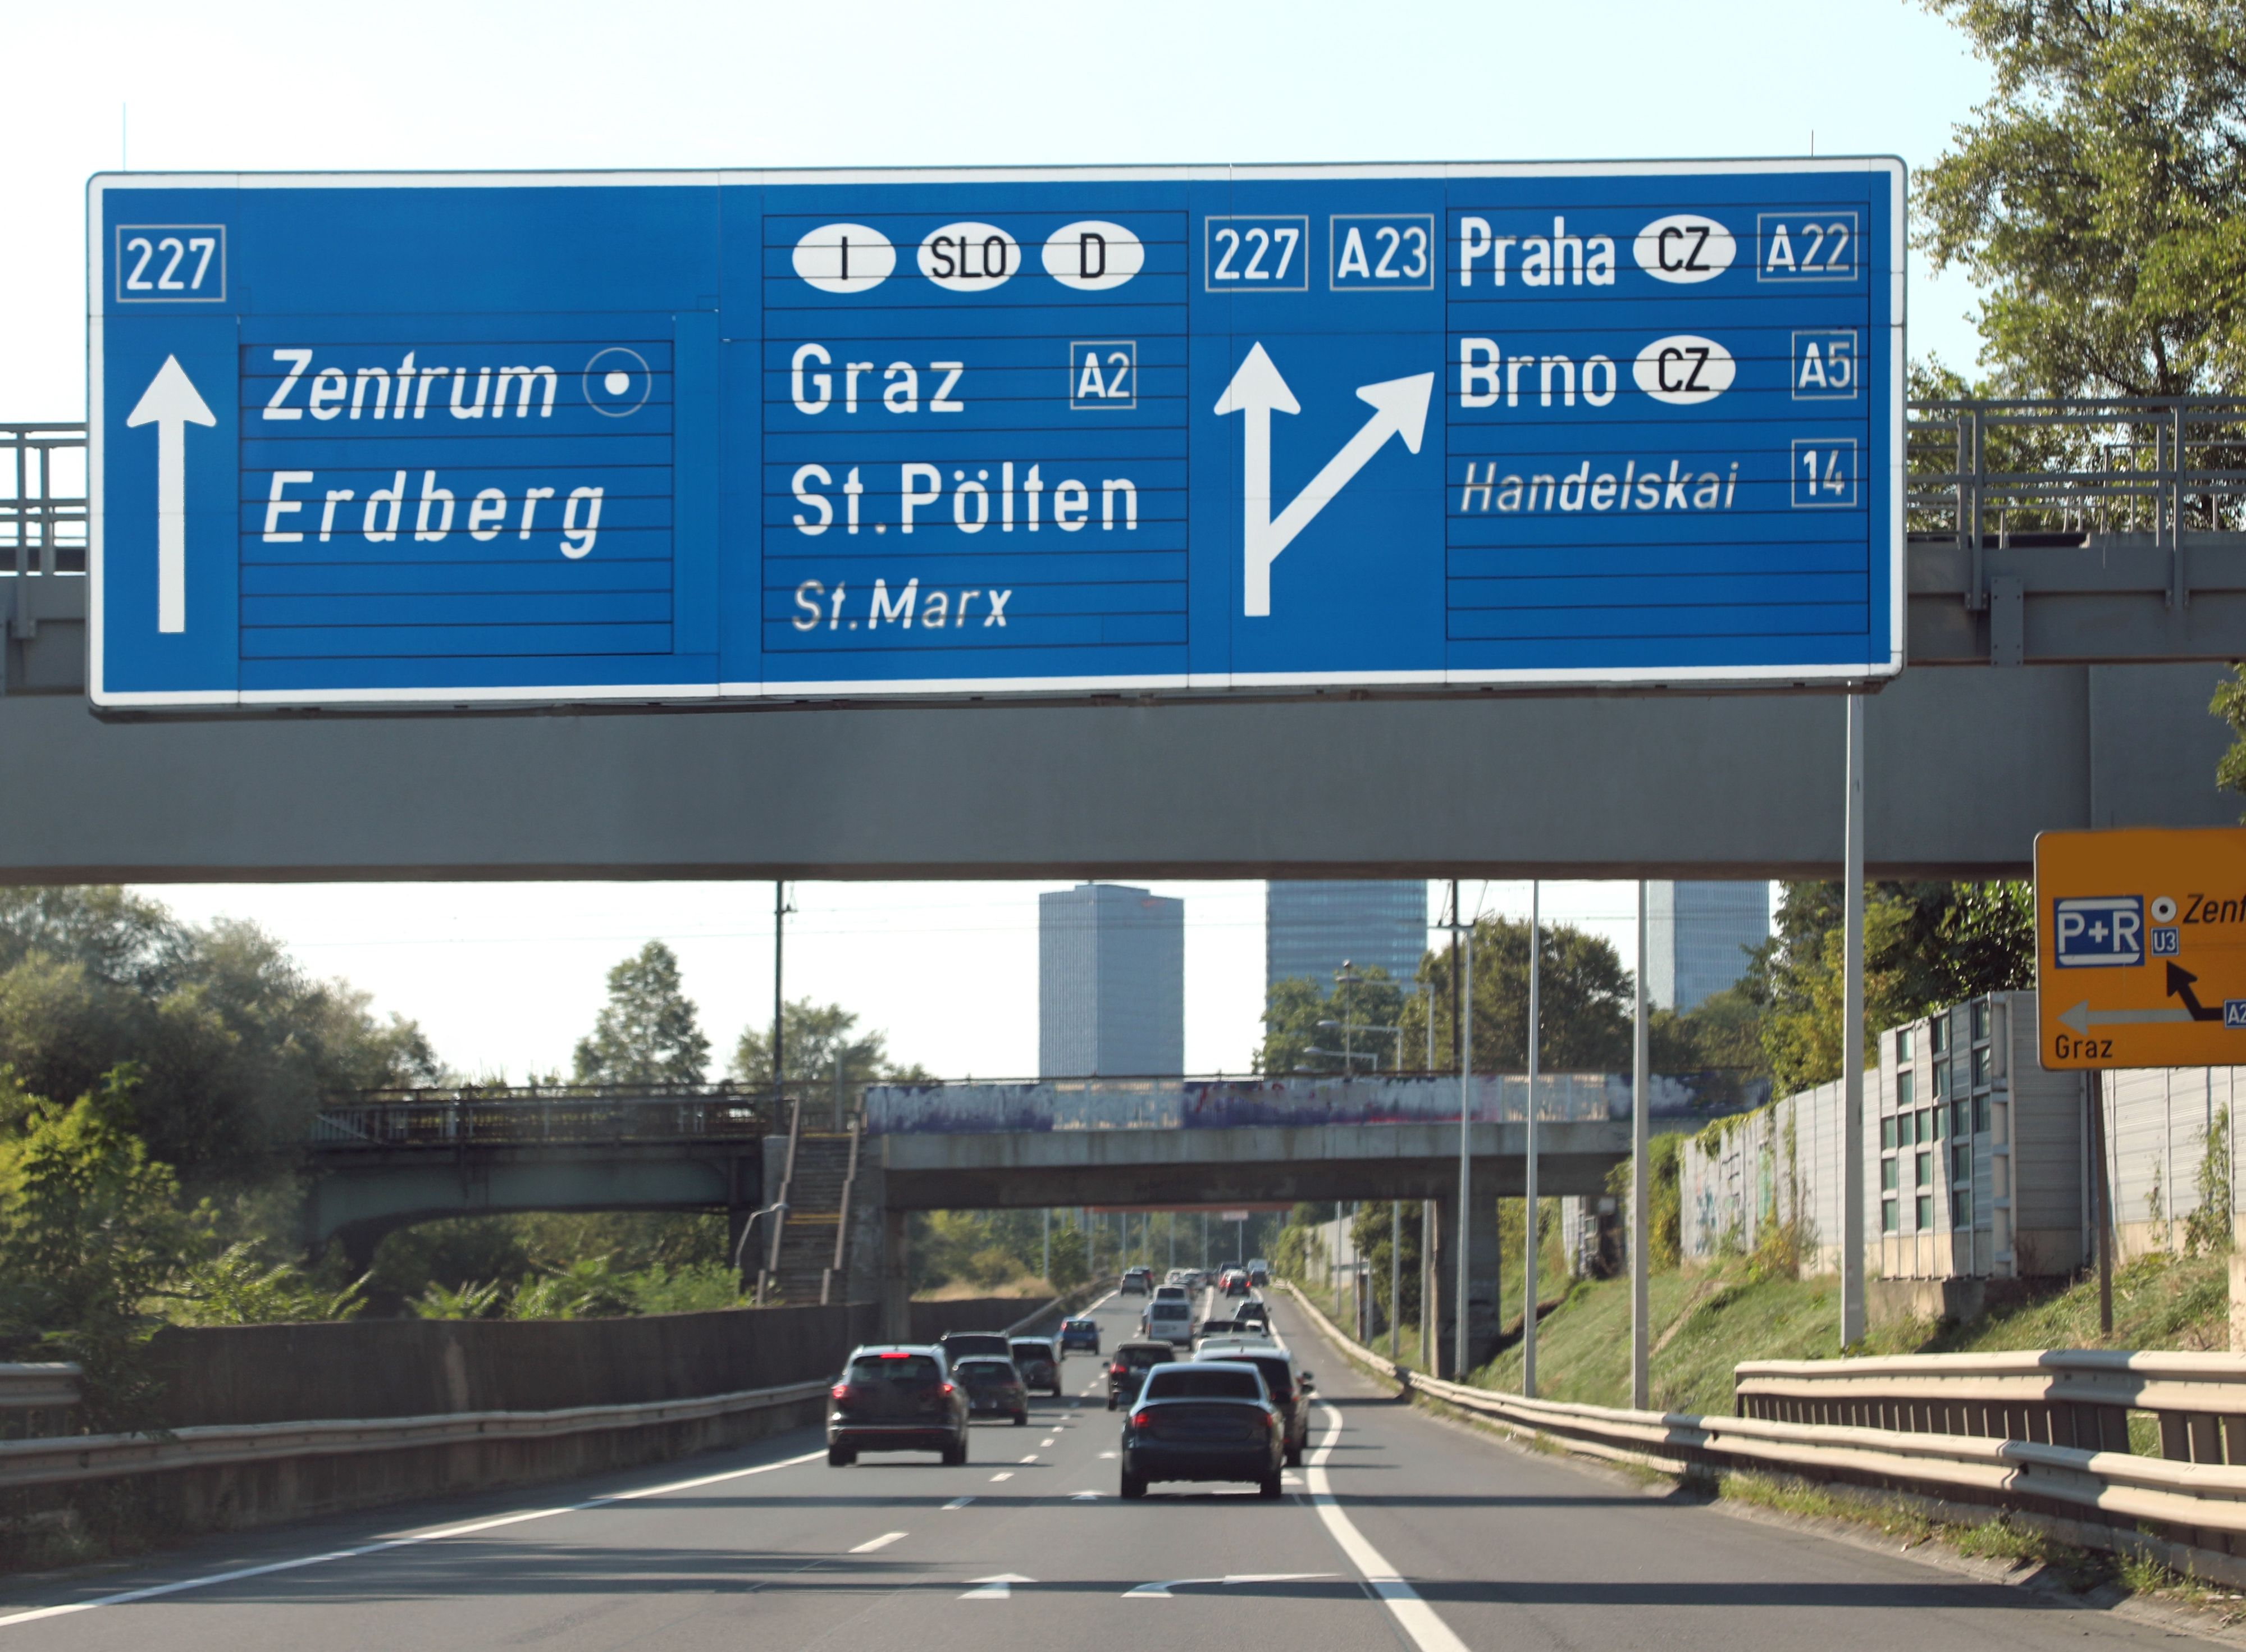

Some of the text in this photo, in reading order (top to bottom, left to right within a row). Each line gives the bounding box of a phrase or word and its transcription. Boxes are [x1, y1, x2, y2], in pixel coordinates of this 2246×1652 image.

[126, 238, 216, 290] 227
[839, 236, 849, 280] I
[930, 235, 1007, 279] SLO
[1079, 232, 1106, 279] D
[1215, 227, 1299, 280] 227
[1337, 226, 1427, 279] A23
[1460, 216, 1615, 286] Praha
[1658, 226, 1711, 272] CZ
[1765, 223, 1850, 272] A22
[262, 349, 558, 421] Zentrum
[791, 343, 964, 414] Graz
[1077, 352, 1130, 399] A2
[1460, 337, 1617, 408] Brno
[1657, 346, 1711, 393] CZ
[1798, 341, 1851, 389] A5
[1461, 459, 1739, 512] Handelskai
[1803, 450, 1845, 496] 14
[262, 469, 604, 559] Erdberg
[2153, 932, 2177, 952] U3
[2055, 1034, 2113, 1060] Graz
